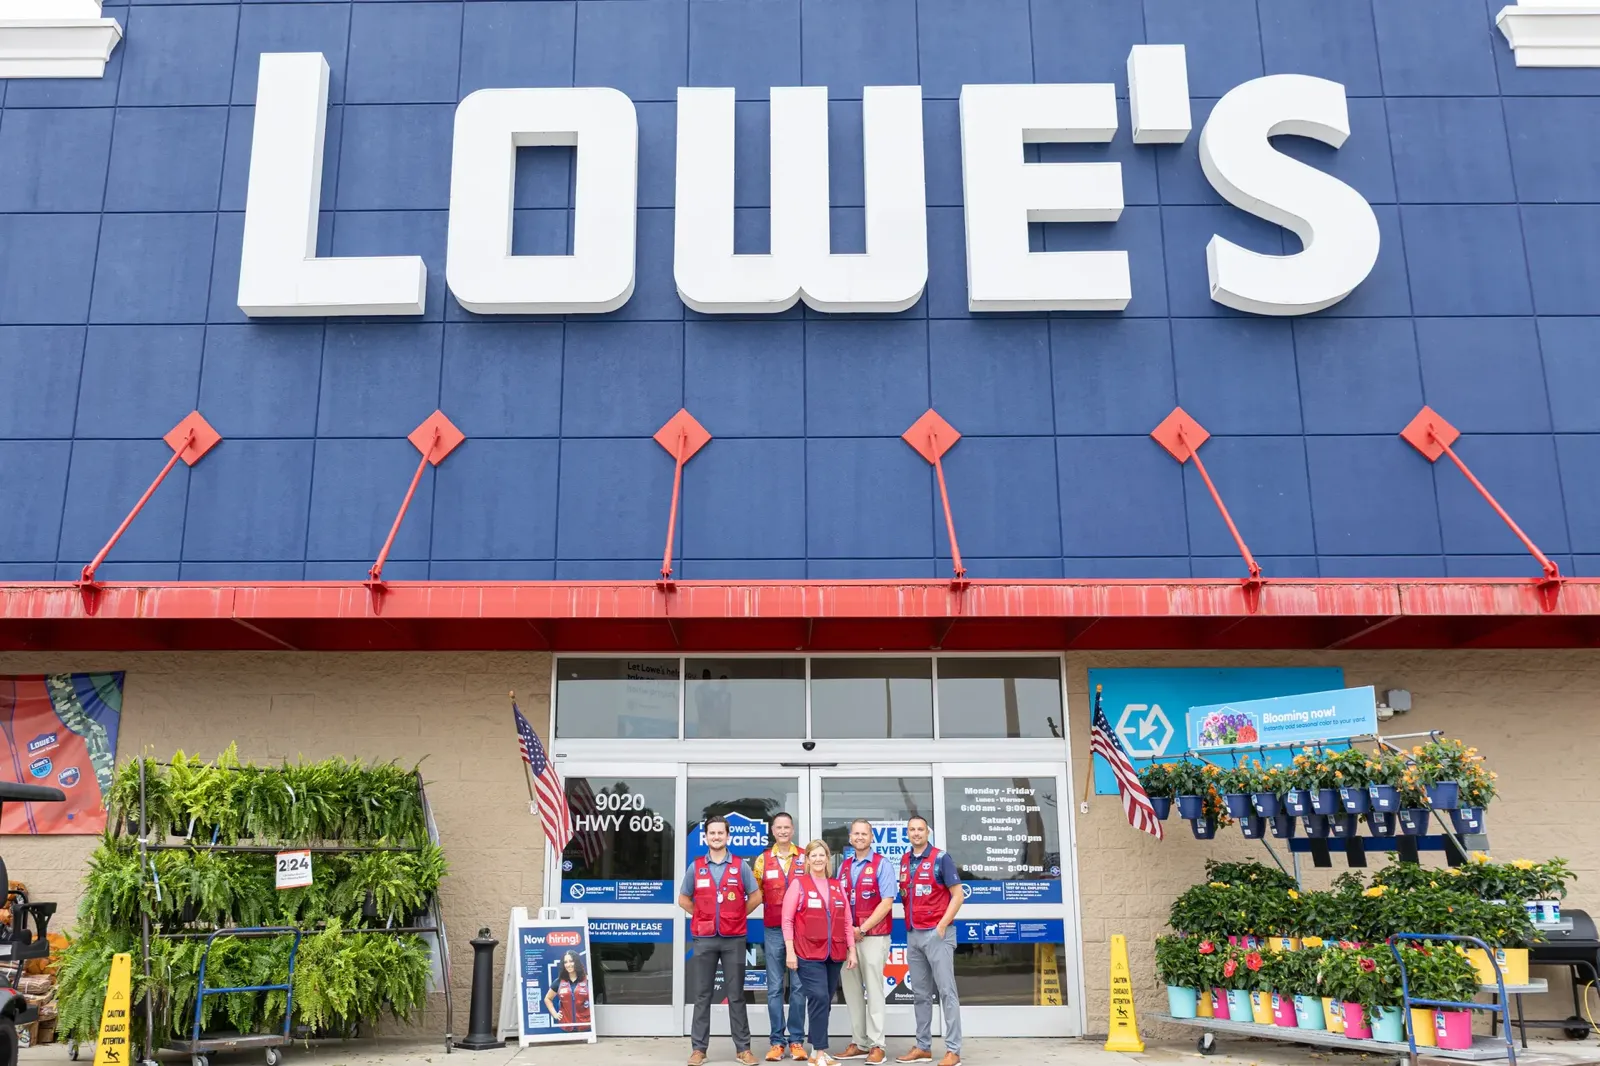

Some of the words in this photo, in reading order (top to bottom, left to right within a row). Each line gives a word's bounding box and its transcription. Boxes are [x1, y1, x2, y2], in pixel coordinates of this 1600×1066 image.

[237, 44, 1380, 316] LOWE'S
[628, 661, 640, 671] Let
[641, 663, 665, 675] Lowe's
[1263, 709, 1309, 724] Blooming
[1311, 705, 1336, 719] now!
[1263, 723, 1284, 731] Instantly
[1285, 722, 1296, 730] add
[1296, 721, 1319, 729] seasonal
[30, 735, 56, 751] LOWE'S
[964, 787, 1000, 796] Monday
[1006, 787, 1036, 796] Friday
[595, 793, 645, 811] 9020
[575, 815, 624, 832] HWY
[629, 815, 664, 832] 603
[981, 816, 1022, 825] Saturday
[729, 823, 756, 833] owe's
[876, 846, 908, 855] EVERY
[986, 847, 1019, 856] Sunday
[279, 859, 287, 872] 2
[290, 857, 309, 871] 24
[631, 922, 662, 931] PLEASE
[524, 934, 546, 944] Now
[548, 932, 579, 945] hiring!
[107, 1010, 126, 1018] CAUTION
[104, 1024, 126, 1032] CUIDADO
[102, 1037, 126, 1046] ATTENTION
